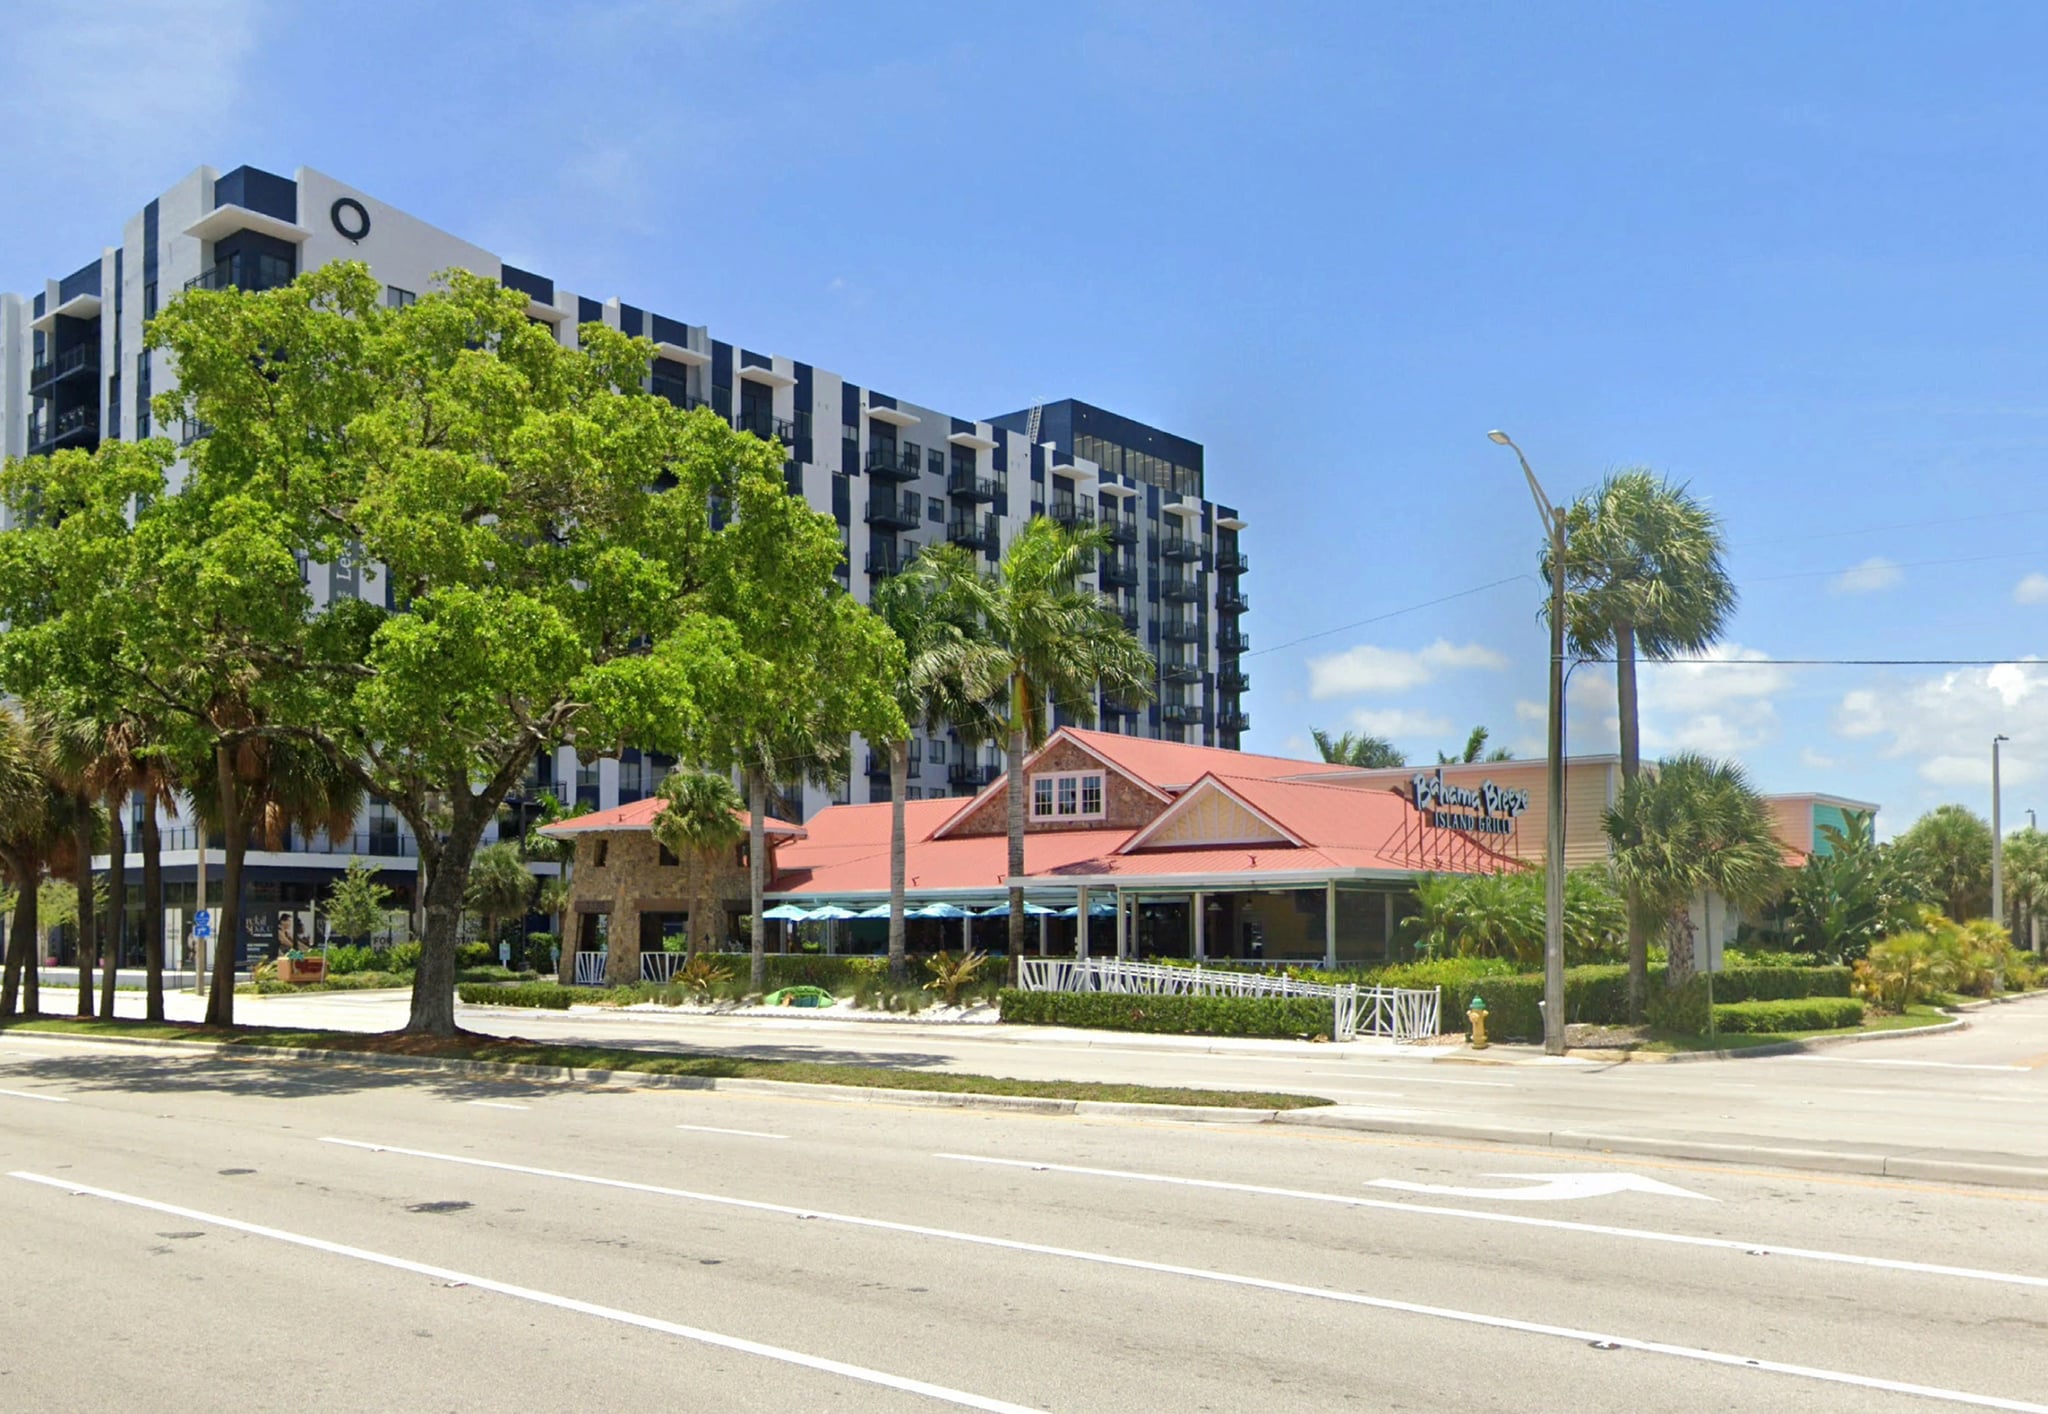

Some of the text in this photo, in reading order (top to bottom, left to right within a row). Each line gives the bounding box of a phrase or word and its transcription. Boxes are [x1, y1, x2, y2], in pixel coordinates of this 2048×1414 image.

[1412, 769, 1529, 818] Bahama Breeze
[1434, 812, 1512, 834] ISLAND GRILL
